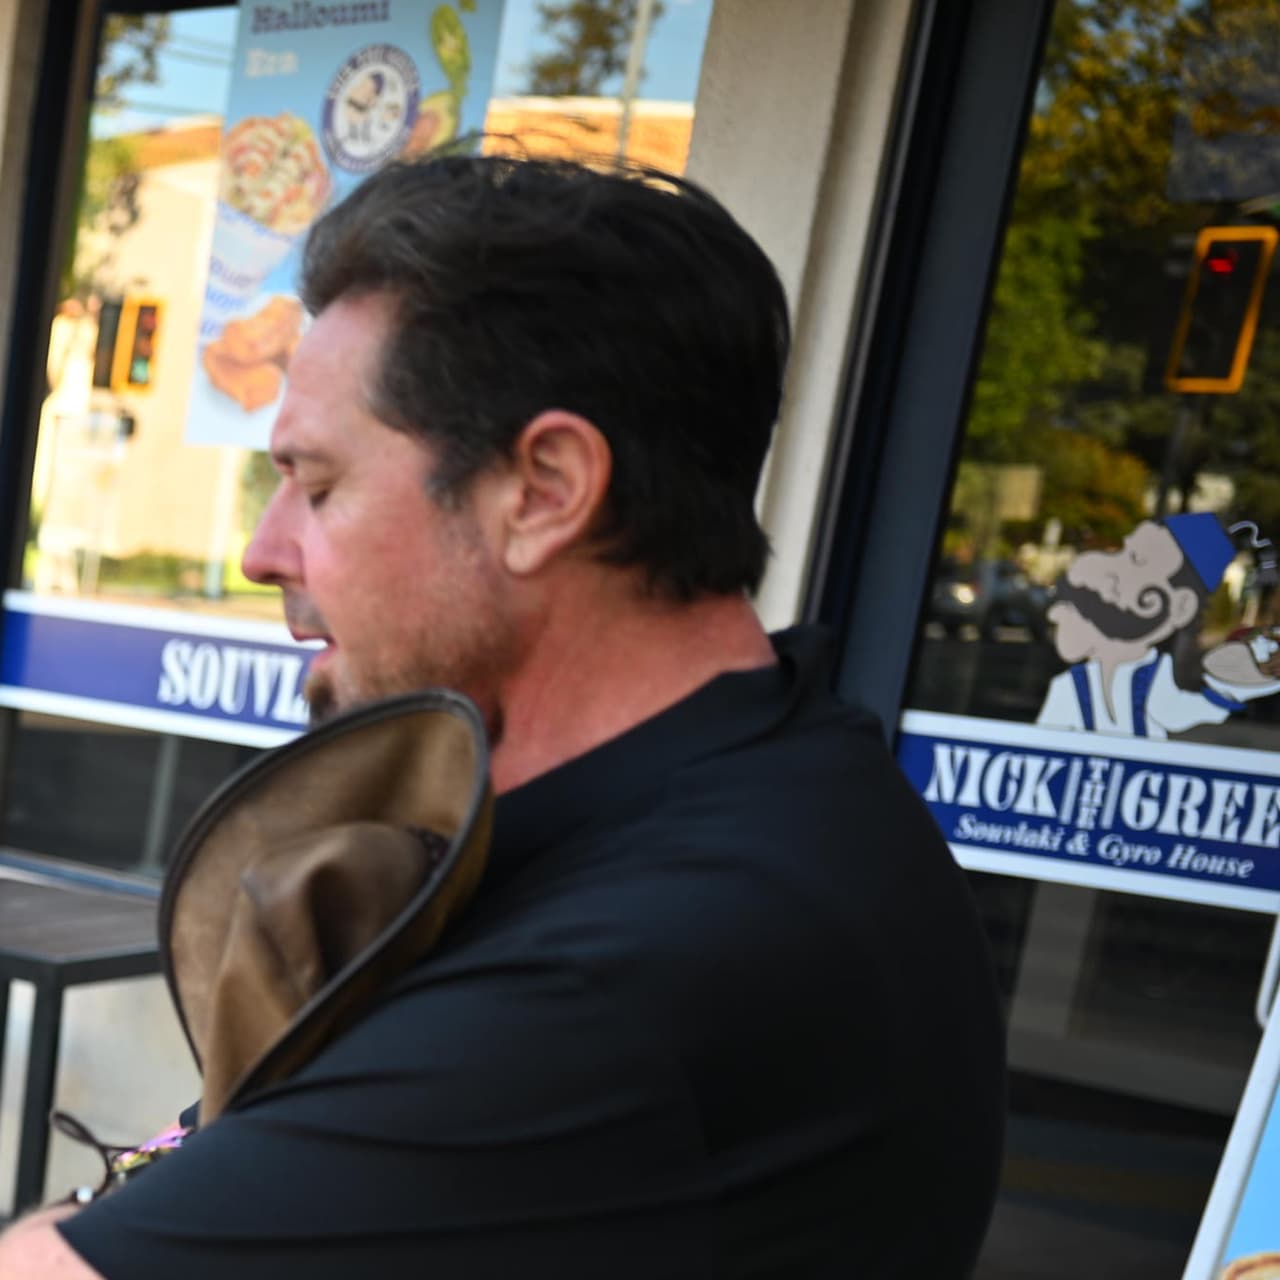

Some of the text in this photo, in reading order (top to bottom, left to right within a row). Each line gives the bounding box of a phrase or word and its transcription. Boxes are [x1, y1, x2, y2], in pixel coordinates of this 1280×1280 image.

[252, 0, 391, 34] Halloumi
[157, 638, 310, 725] SOUVL
[924, 743, 1280, 848] NICK THE GREE
[954, 812, 1255, 880] Souvlaki & Gyro House
